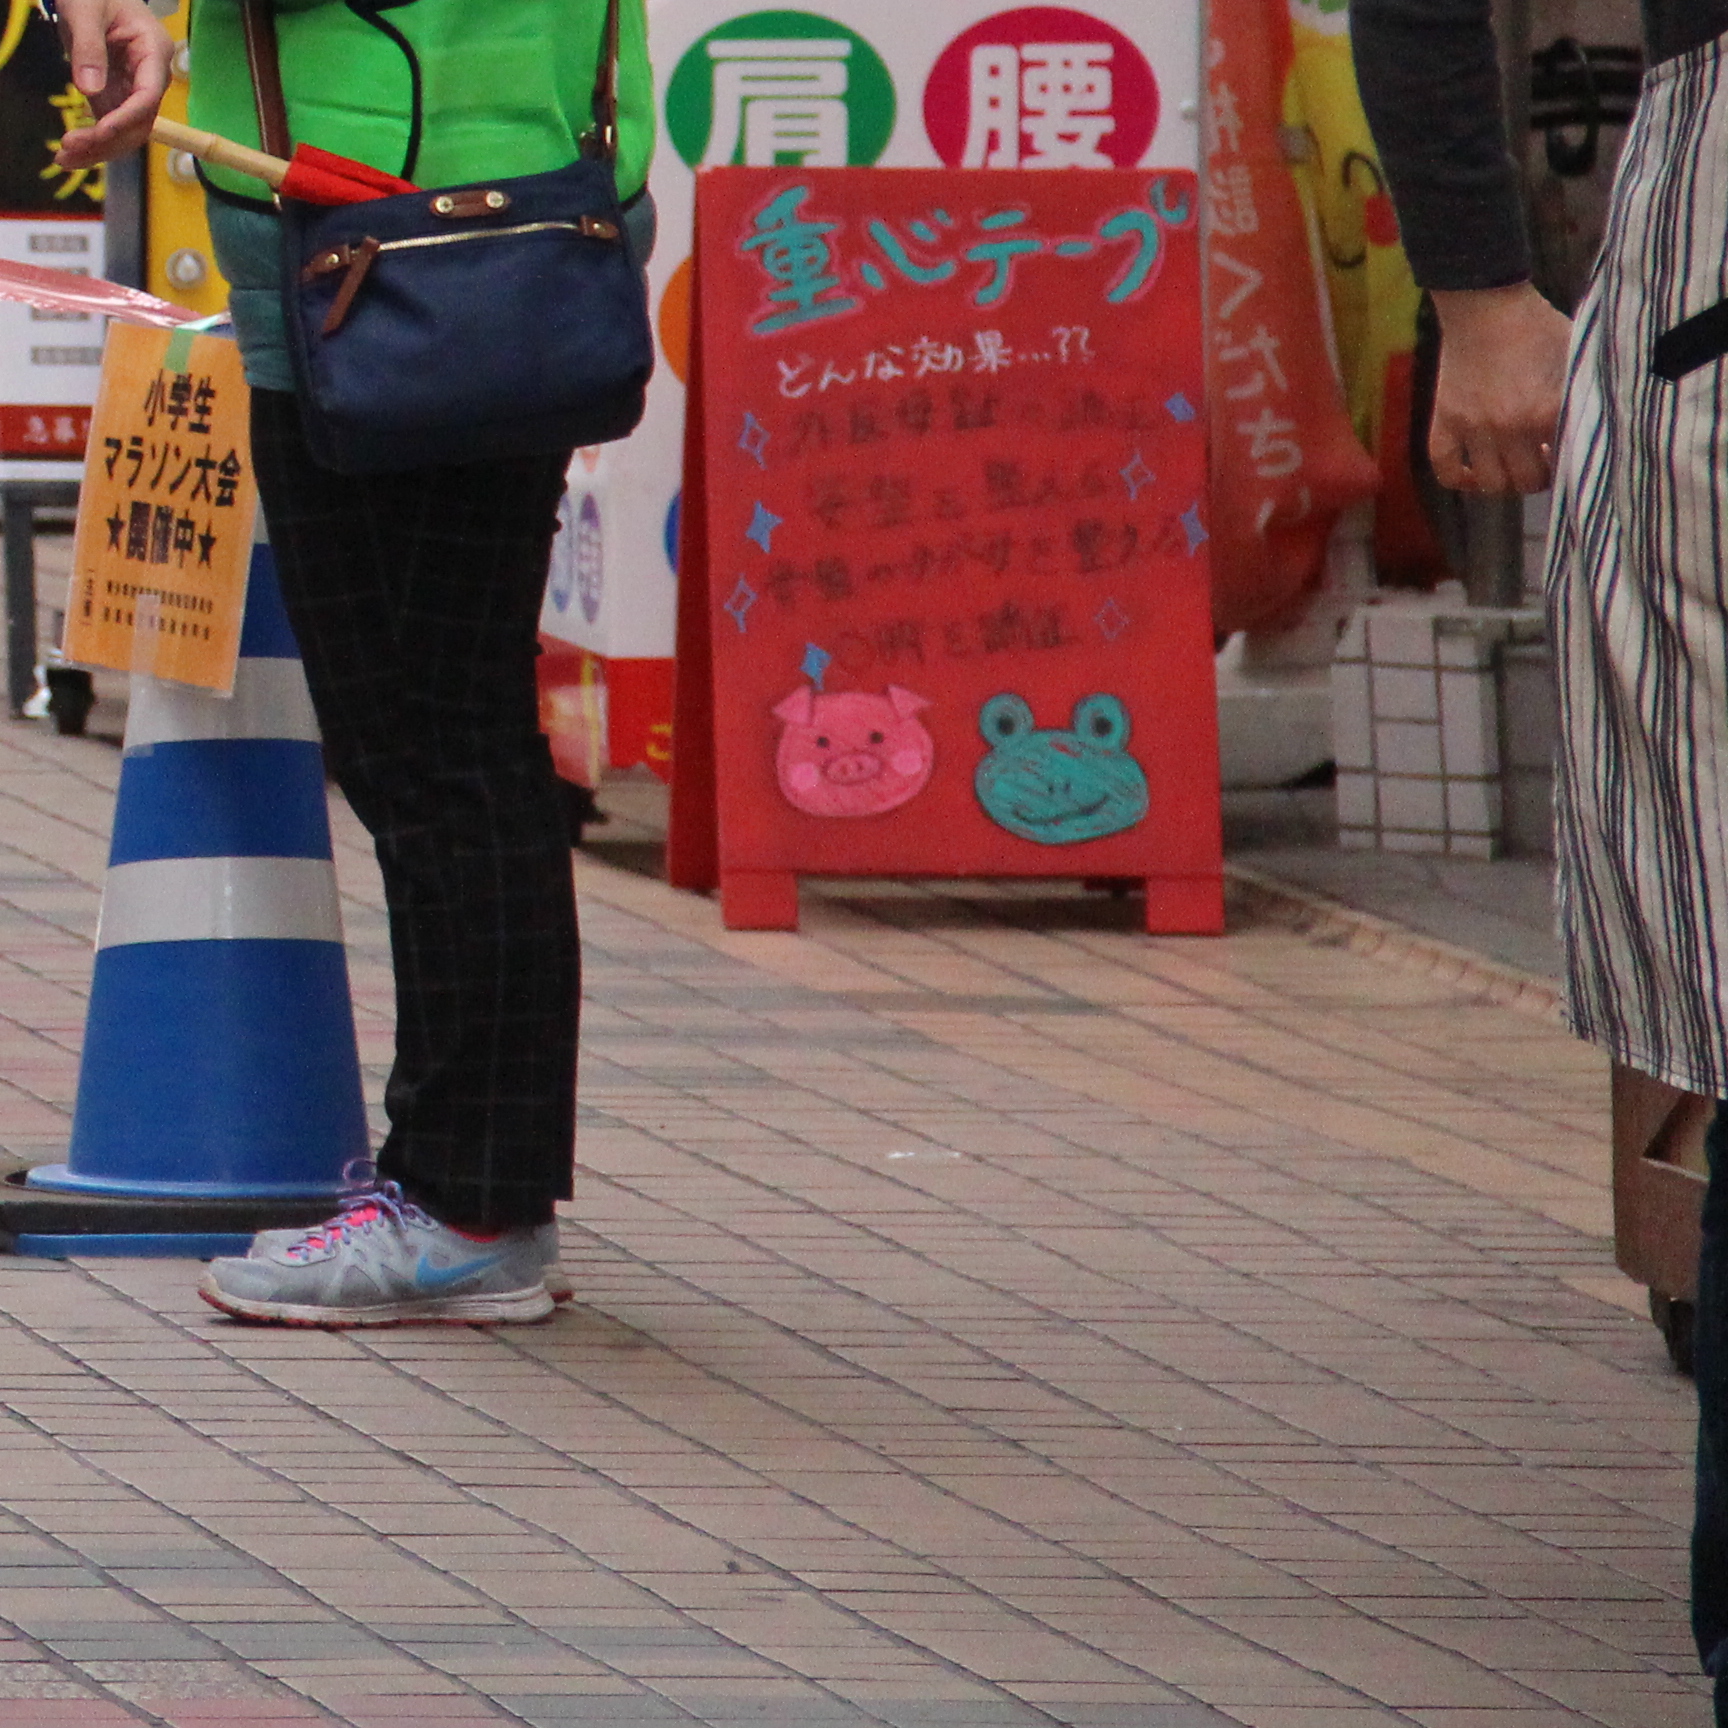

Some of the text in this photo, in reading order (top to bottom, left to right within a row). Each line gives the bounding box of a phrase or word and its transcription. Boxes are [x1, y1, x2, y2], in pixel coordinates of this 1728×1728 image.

[704, 38, 1116, 168] 肩 腰
[741, 176, 1193, 335] 重心テープ
[144, 367, 216, 434] 小学生
[103, 435, 243, 508] マラソン大会
